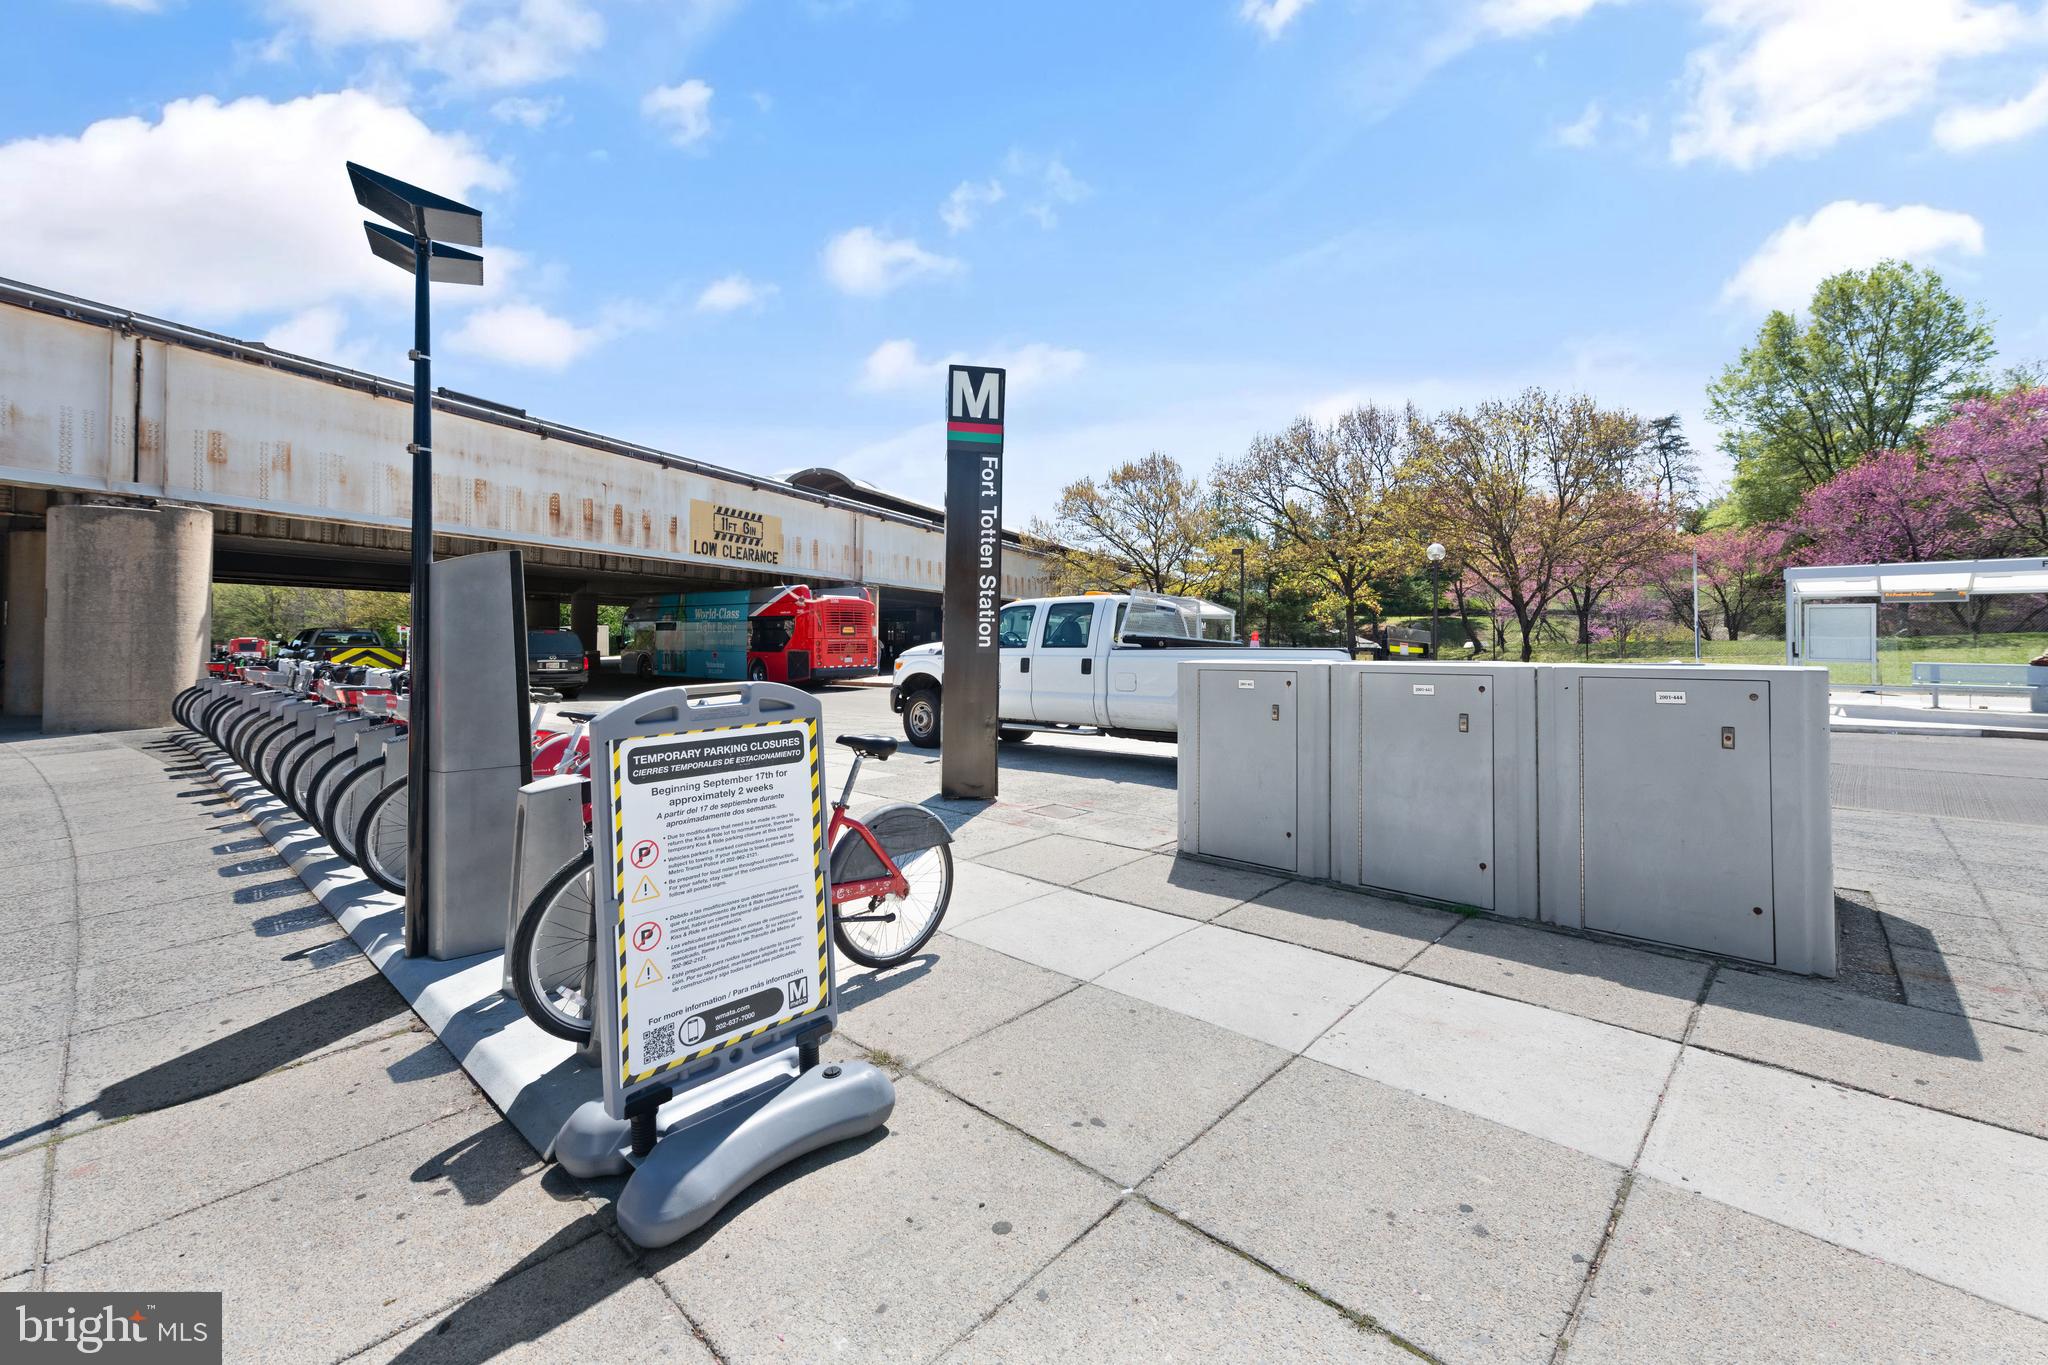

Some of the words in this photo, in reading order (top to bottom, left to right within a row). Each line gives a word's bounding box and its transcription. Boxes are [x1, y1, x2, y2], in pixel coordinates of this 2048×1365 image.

[952, 370, 1000, 419] M
[981, 456, 998, 496] Fort
[980, 506, 998, 569] Totten
[694, 540, 717, 556] LOW
[723, 545, 778, 564] CLEARANCE
[695, 608, 740, 620] World-Class
[978, 575, 997, 648] Station
[632, 765, 668, 776] CIERRES
[670, 758, 722, 771] TEMPORALES
[735, 749, 800, 763] ESTACIONAMIENTO
[633, 748, 700, 764] TEMPORARY
[703, 743, 747, 756] PARKING
[750, 737, 799, 750] CLOSURES
[651, 782, 700, 796] Beginning
[703, 775, 752, 788] September
[755, 771, 773, 780] 17th
[668, 789, 735, 806] approximately
[738, 786, 743, 794] 2
[745, 783, 773, 793] weeks
[663, 809, 685, 819] partir
[686, 806, 698, 814] del
[720, 797, 758, 808] septiembre
[759, 793, 784, 802] durante
[665, 811, 730, 827] aproximadamente
[746, 803, 776, 813] semanas.
[648, 1016, 661, 1025] For
[663, 1009, 683, 1020] more
[684, 994, 726, 1012] information
[732, 986, 748, 996] Para
[750, 981, 764, 990] más
[765, 968, 803, 984] información
[790, 978, 806, 1002] M
[790, 998, 807, 1007] metro
[714, 1004, 750, 1020] wmata.com
[715, 1011, 755, 1030] 202-637-7000
